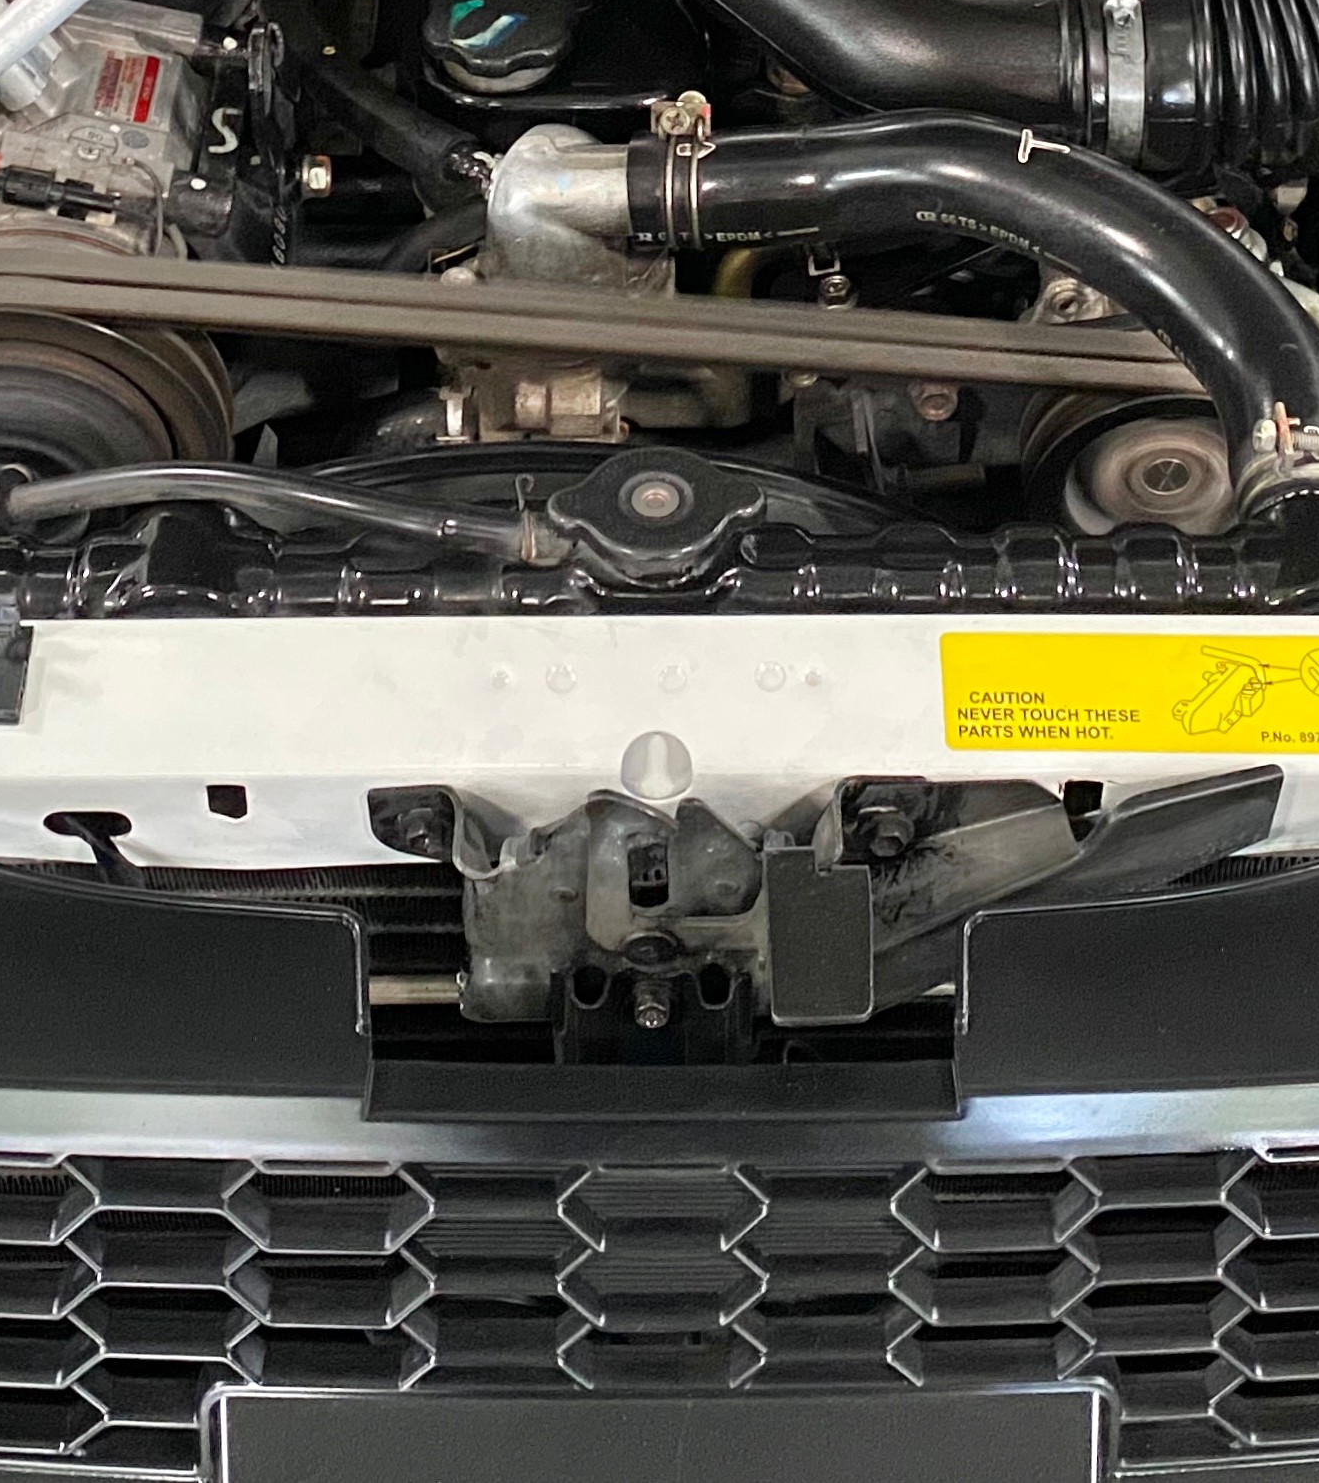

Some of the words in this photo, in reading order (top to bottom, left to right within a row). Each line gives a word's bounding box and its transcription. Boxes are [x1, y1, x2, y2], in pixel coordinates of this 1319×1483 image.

[969, 691, 1045, 705] CAUTION
[957, 707, 1015, 721] NEVER
[1020, 708, 1080, 722] TOUCH
[1084, 708, 1141, 723] THESE
[958, 725, 1014, 739] PARTS
[1018, 726, 1070, 739] WHEN
[1075, 726, 1115, 740] HOT.
[1261, 731, 1296, 743] P.No.
